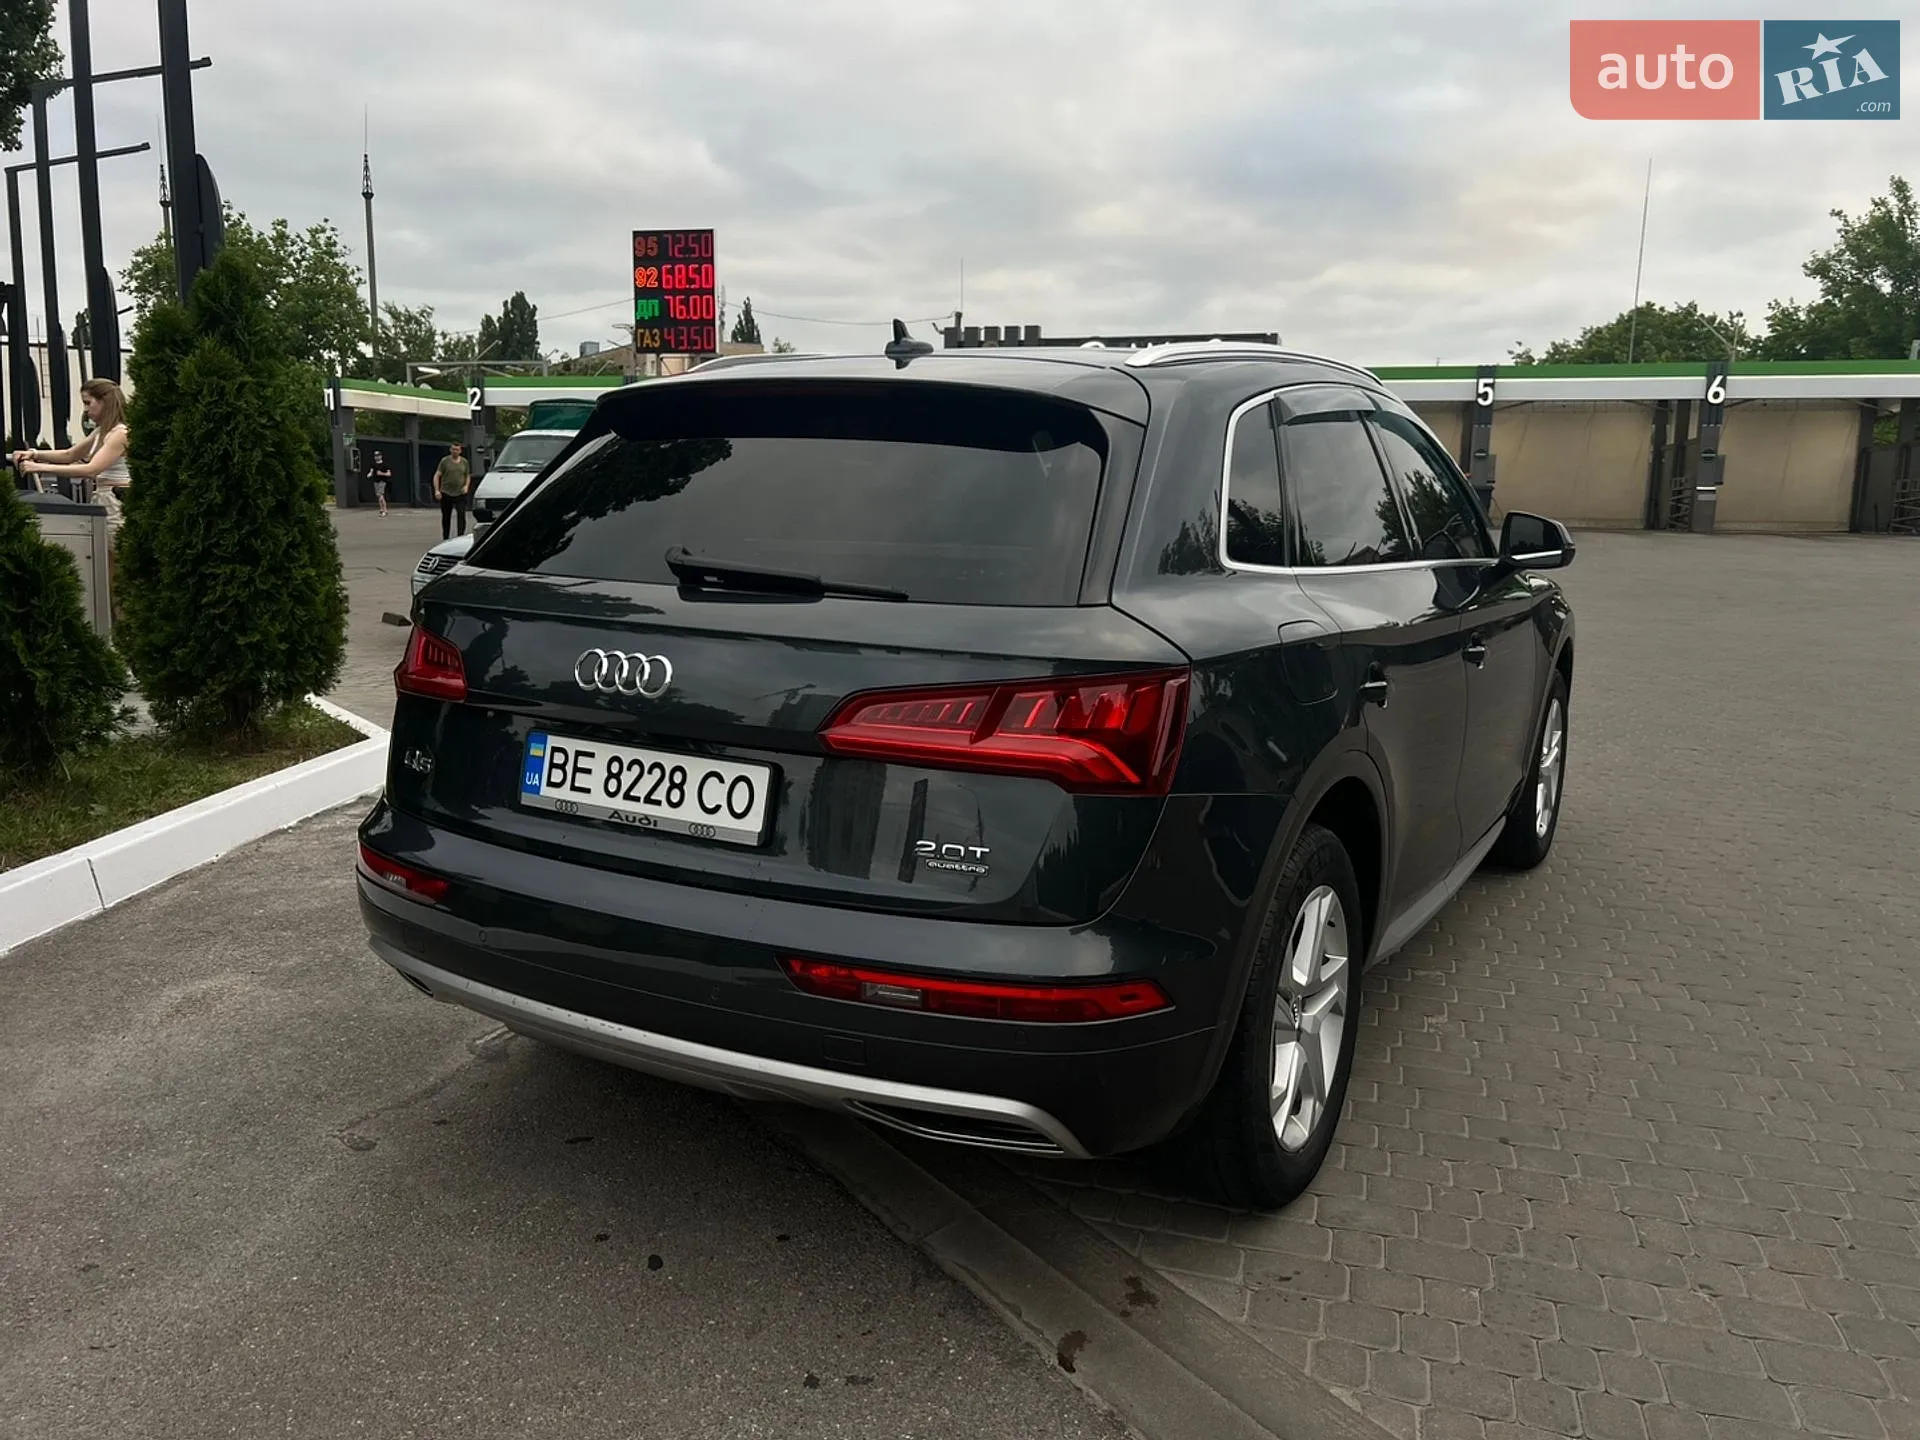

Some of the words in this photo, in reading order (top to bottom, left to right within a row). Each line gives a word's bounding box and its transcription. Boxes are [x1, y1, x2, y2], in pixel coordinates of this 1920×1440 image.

[635, 236, 658, 257] 95
[635, 266, 658, 288] 92
[662, 264, 713, 289] 68.50
[664, 295, 713, 319] 76.00
[637, 328, 660, 348] ГАЗ
[468, 387, 482, 410] 2
[1477, 378, 1494, 406] 5
[1707, 375, 1726, 404] 6
[525, 771, 540, 787] UA
[546, 746, 595, 794] BE
[604, 755, 687, 809] 8228
[697, 770, 755, 820] CO
[608, 810, 658, 828] Audi
